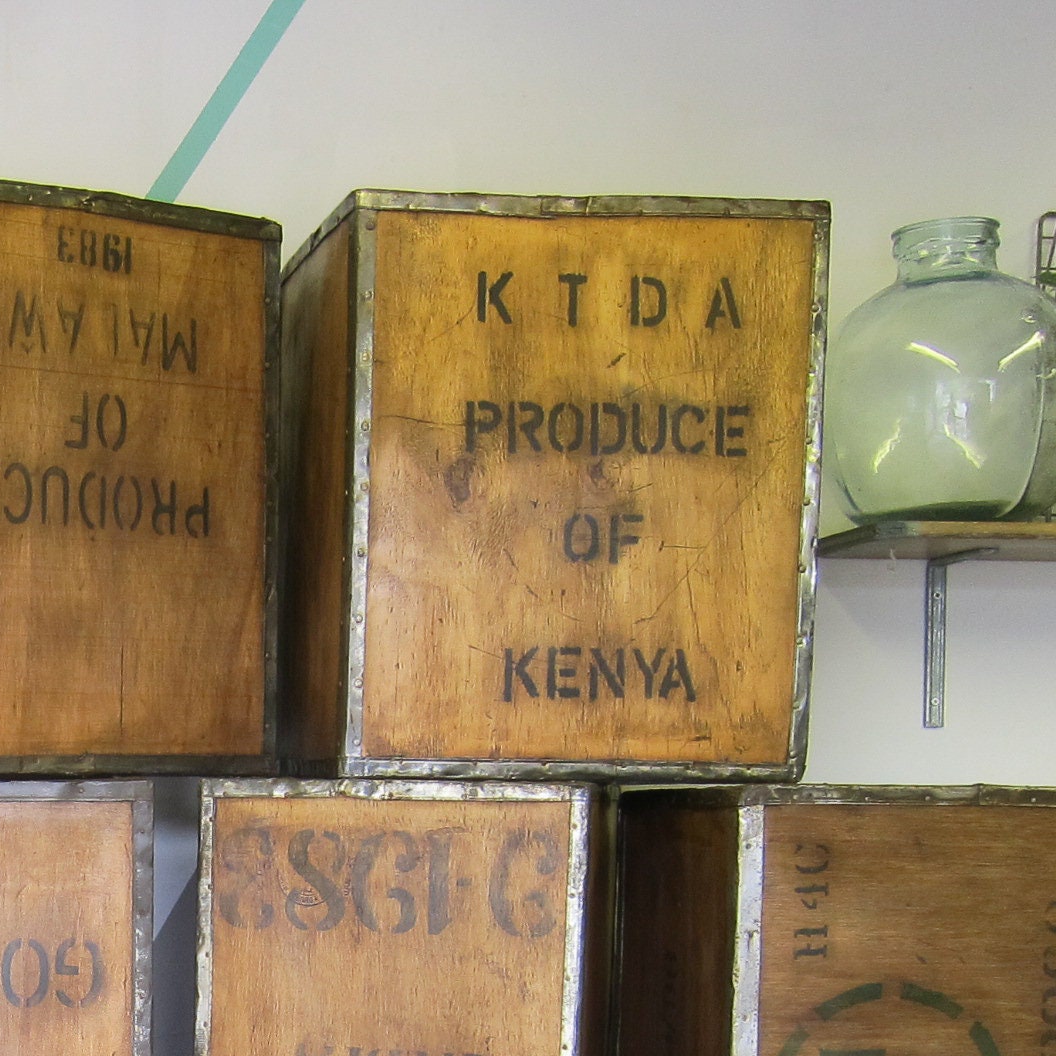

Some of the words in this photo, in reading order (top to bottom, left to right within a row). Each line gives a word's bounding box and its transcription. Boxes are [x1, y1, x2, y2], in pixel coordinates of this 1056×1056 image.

[57, 225, 133, 275] 1983
[64, 390, 127, 452] OF
[465, 400, 750, 458] PRODUCE
[562, 513, 645, 565] OF
[502, 646, 697, 703] KENYA
